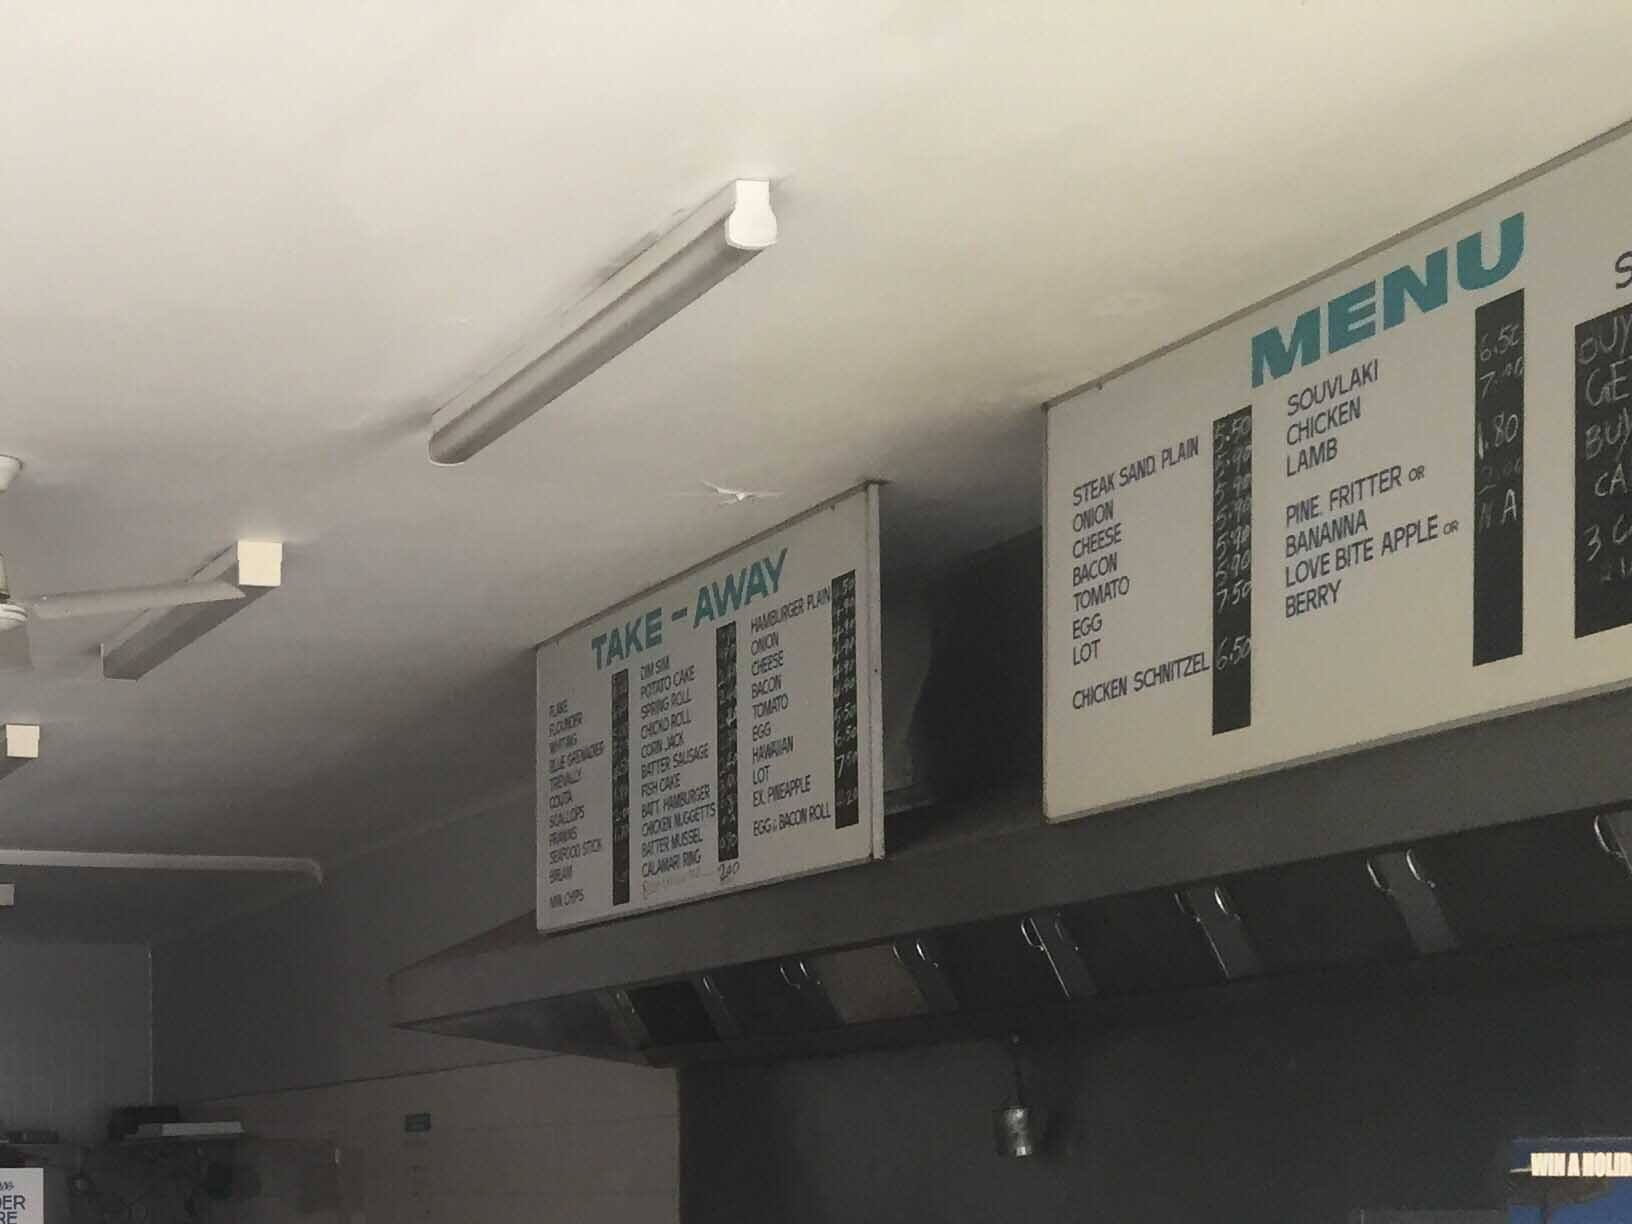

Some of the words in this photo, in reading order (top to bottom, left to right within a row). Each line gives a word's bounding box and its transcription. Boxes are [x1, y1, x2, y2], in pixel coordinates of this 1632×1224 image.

[1252, 211, 1524, 389] MENU
[1288, 359, 1378, 417] SOUVLAKI
[1287, 396, 1361, 447] CHICKEN
[1072, 470, 1114, 507] STEAK
[1161, 436, 1199, 470] PLAIN
[1287, 437, 1338, 478] LAMB
[1330, 465, 1402, 512] FRITTER
[1408, 466, 1425, 482] OR
[1073, 500, 1114, 533] ONION
[1286, 508, 1368, 558] BANANNA
[1073, 523, 1122, 560] CHEESE
[1286, 551, 1331, 588] LOVE
[1335, 537, 1374, 572] BITE
[1381, 514, 1440, 557] APPLE
[1443, 519, 1460, 536] OR
[1073, 552, 1118, 587] BACON
[592, 609, 662, 671] TAKE
[693, 547, 788, 629] AWAY
[751, 597, 804, 633] HAMBURGER
[806, 585, 831, 611] PLAIN
[1073, 575, 1130, 613] TOMATO
[1286, 580, 1342, 618] BERRY
[751, 631, 779, 656] ONION
[1073, 613, 1103, 641] EGG
[752, 650, 784, 676] CHEESE
[1073, 639, 1102, 666] LOT
[641, 675, 671, 699] POTATO
[673, 665, 696, 687] CAKE
[672, 687, 692, 706] ROLL
[752, 675, 782, 699] BACON
[1073, 676, 1128, 710] CHICKEN
[1134, 652, 1210, 692] SCHNITZEL
[672, 709, 692, 728] ROLL
[753, 694, 789, 720] TOMATO
[753, 721, 771, 742] EGG
[641, 756, 671, 779] BATTER
[673, 742, 709, 769] SAUSAGE
[753, 765, 770, 785] LOT
[641, 781, 658, 799] FISH
[659, 772, 680, 793] CAKE
[663, 784, 711, 812] HAMBURGER
[768, 774, 811, 803] PINEAPPLE
[641, 815, 672, 837] CHICKEN
[753, 817, 770, 837] EGG
[779, 807, 807, 830] BACON
[809, 802, 831, 823] ROLL
[641, 836, 670, 858] BATTER
[671, 828, 703, 850] MUSSEL
[1531, 1152, 1566, 1177] WIN
[1567, 1152, 1581, 1177] A
